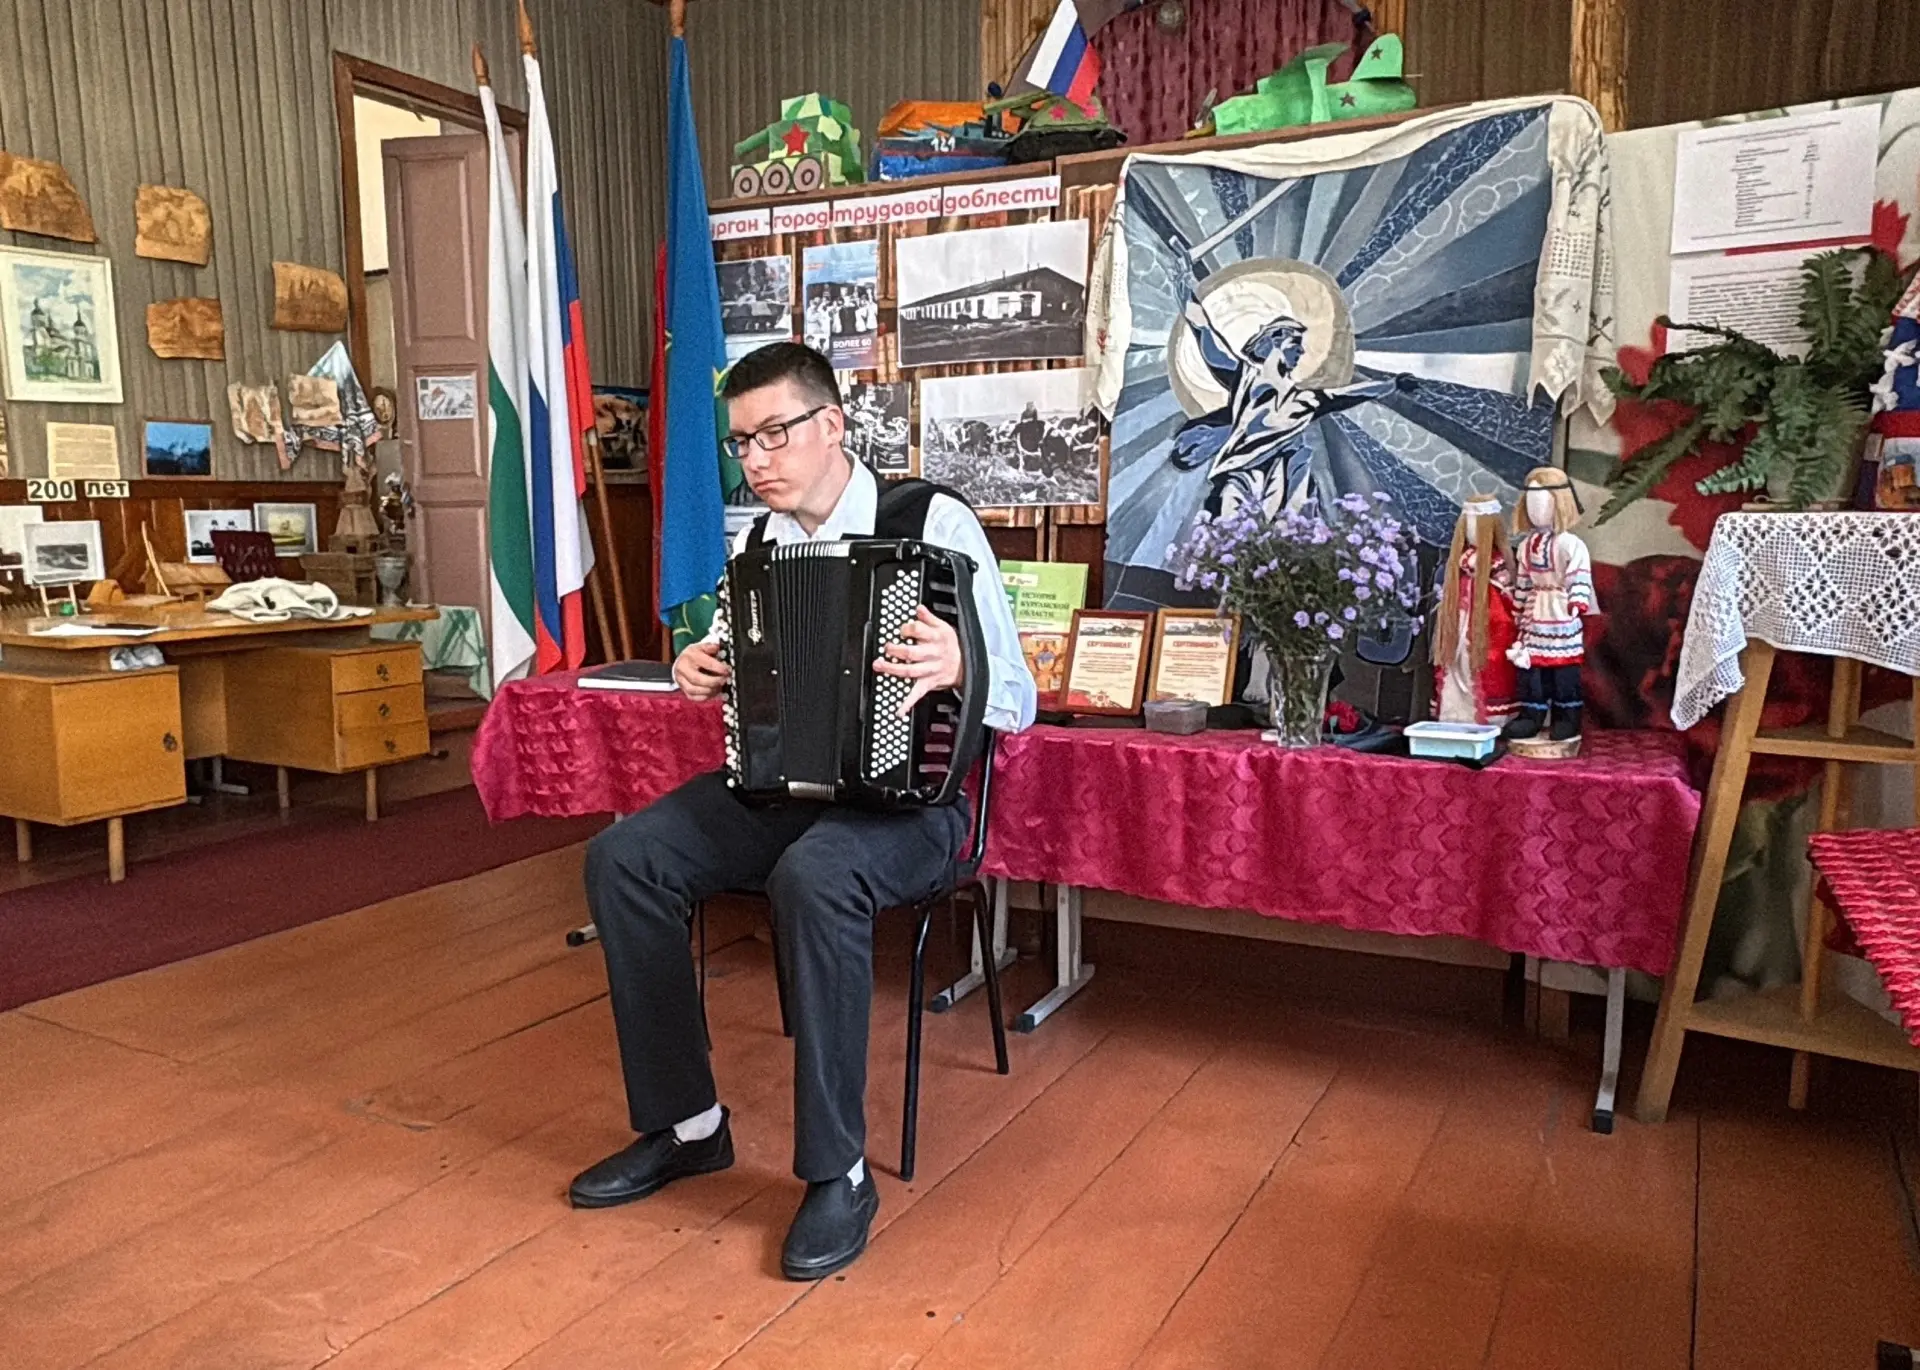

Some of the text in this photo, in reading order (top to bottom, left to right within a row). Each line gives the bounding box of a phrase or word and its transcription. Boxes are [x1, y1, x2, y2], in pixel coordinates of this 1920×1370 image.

[773, 208, 828, 230] город
[835, 194, 941, 225] трудовой
[944, 185, 1059, 214] доблести
[28, 480, 127, 499] 200 лет
